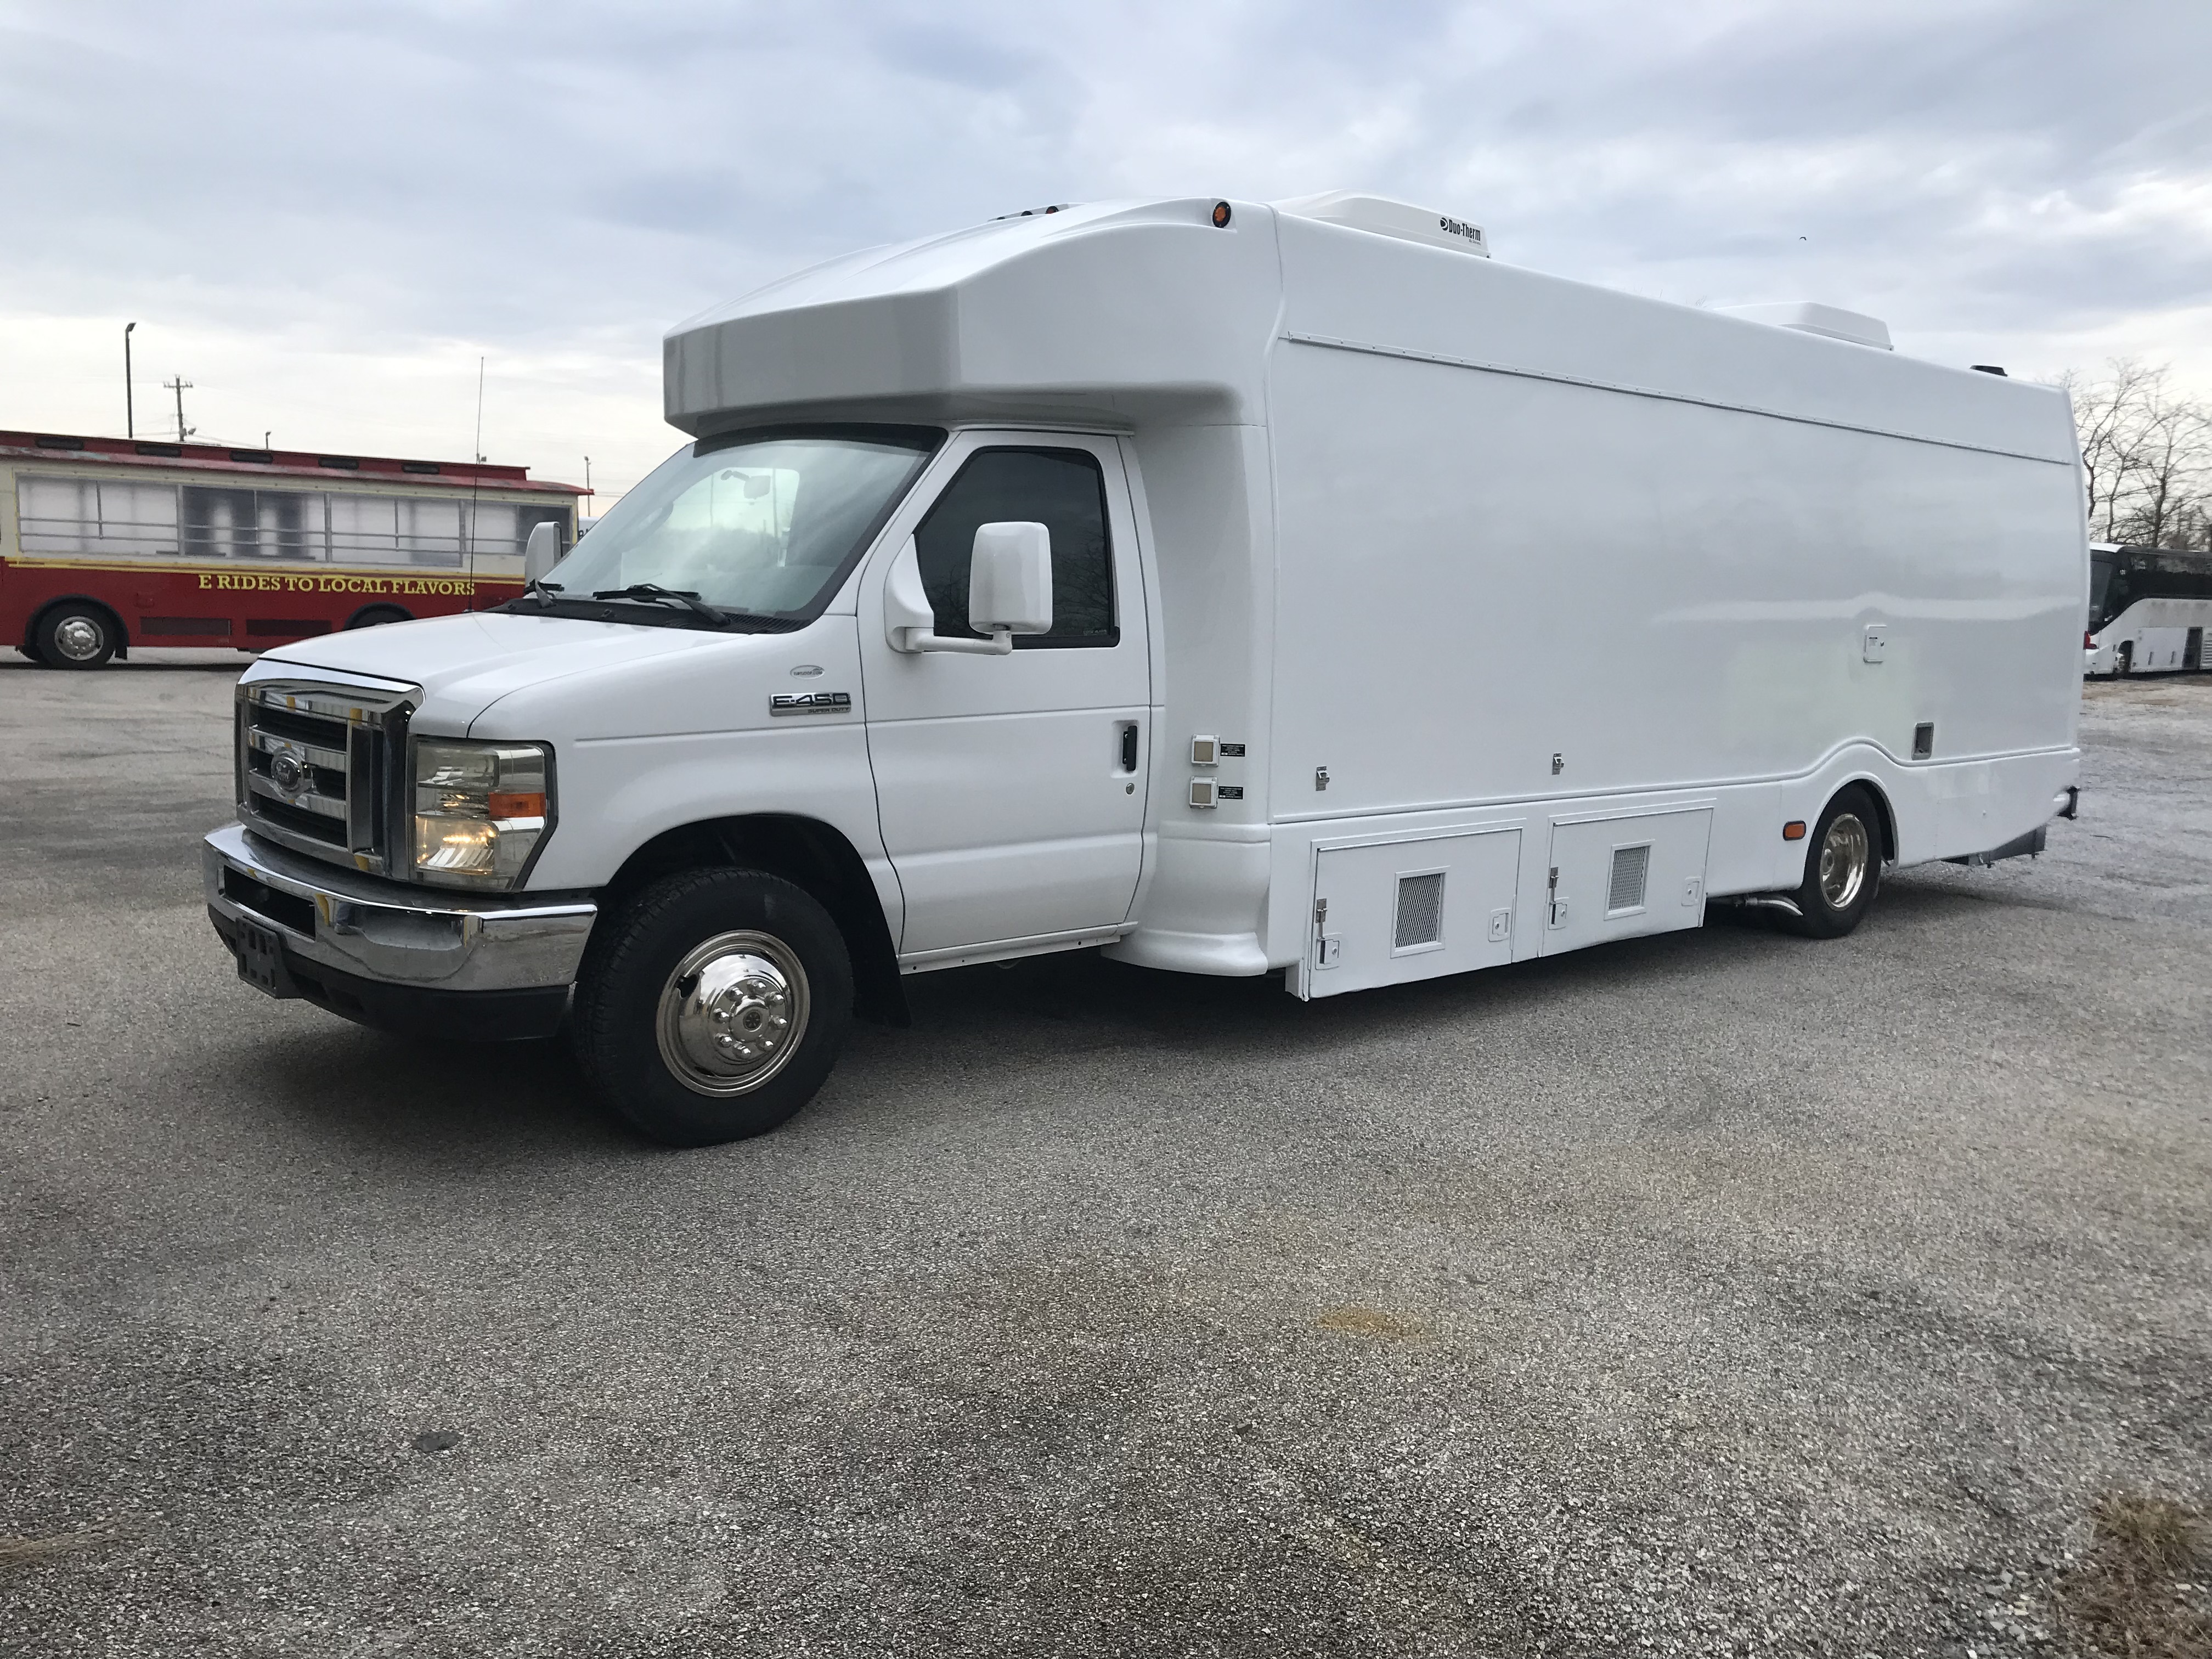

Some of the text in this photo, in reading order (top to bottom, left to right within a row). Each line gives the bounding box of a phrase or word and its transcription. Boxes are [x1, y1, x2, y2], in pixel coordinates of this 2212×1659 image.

[1448, 219, 1481, 241] Duo-Therm
[199, 574, 475, 596] E RIDES TO LOCAL FLAVORS
[772, 693, 851, 708] E-450
